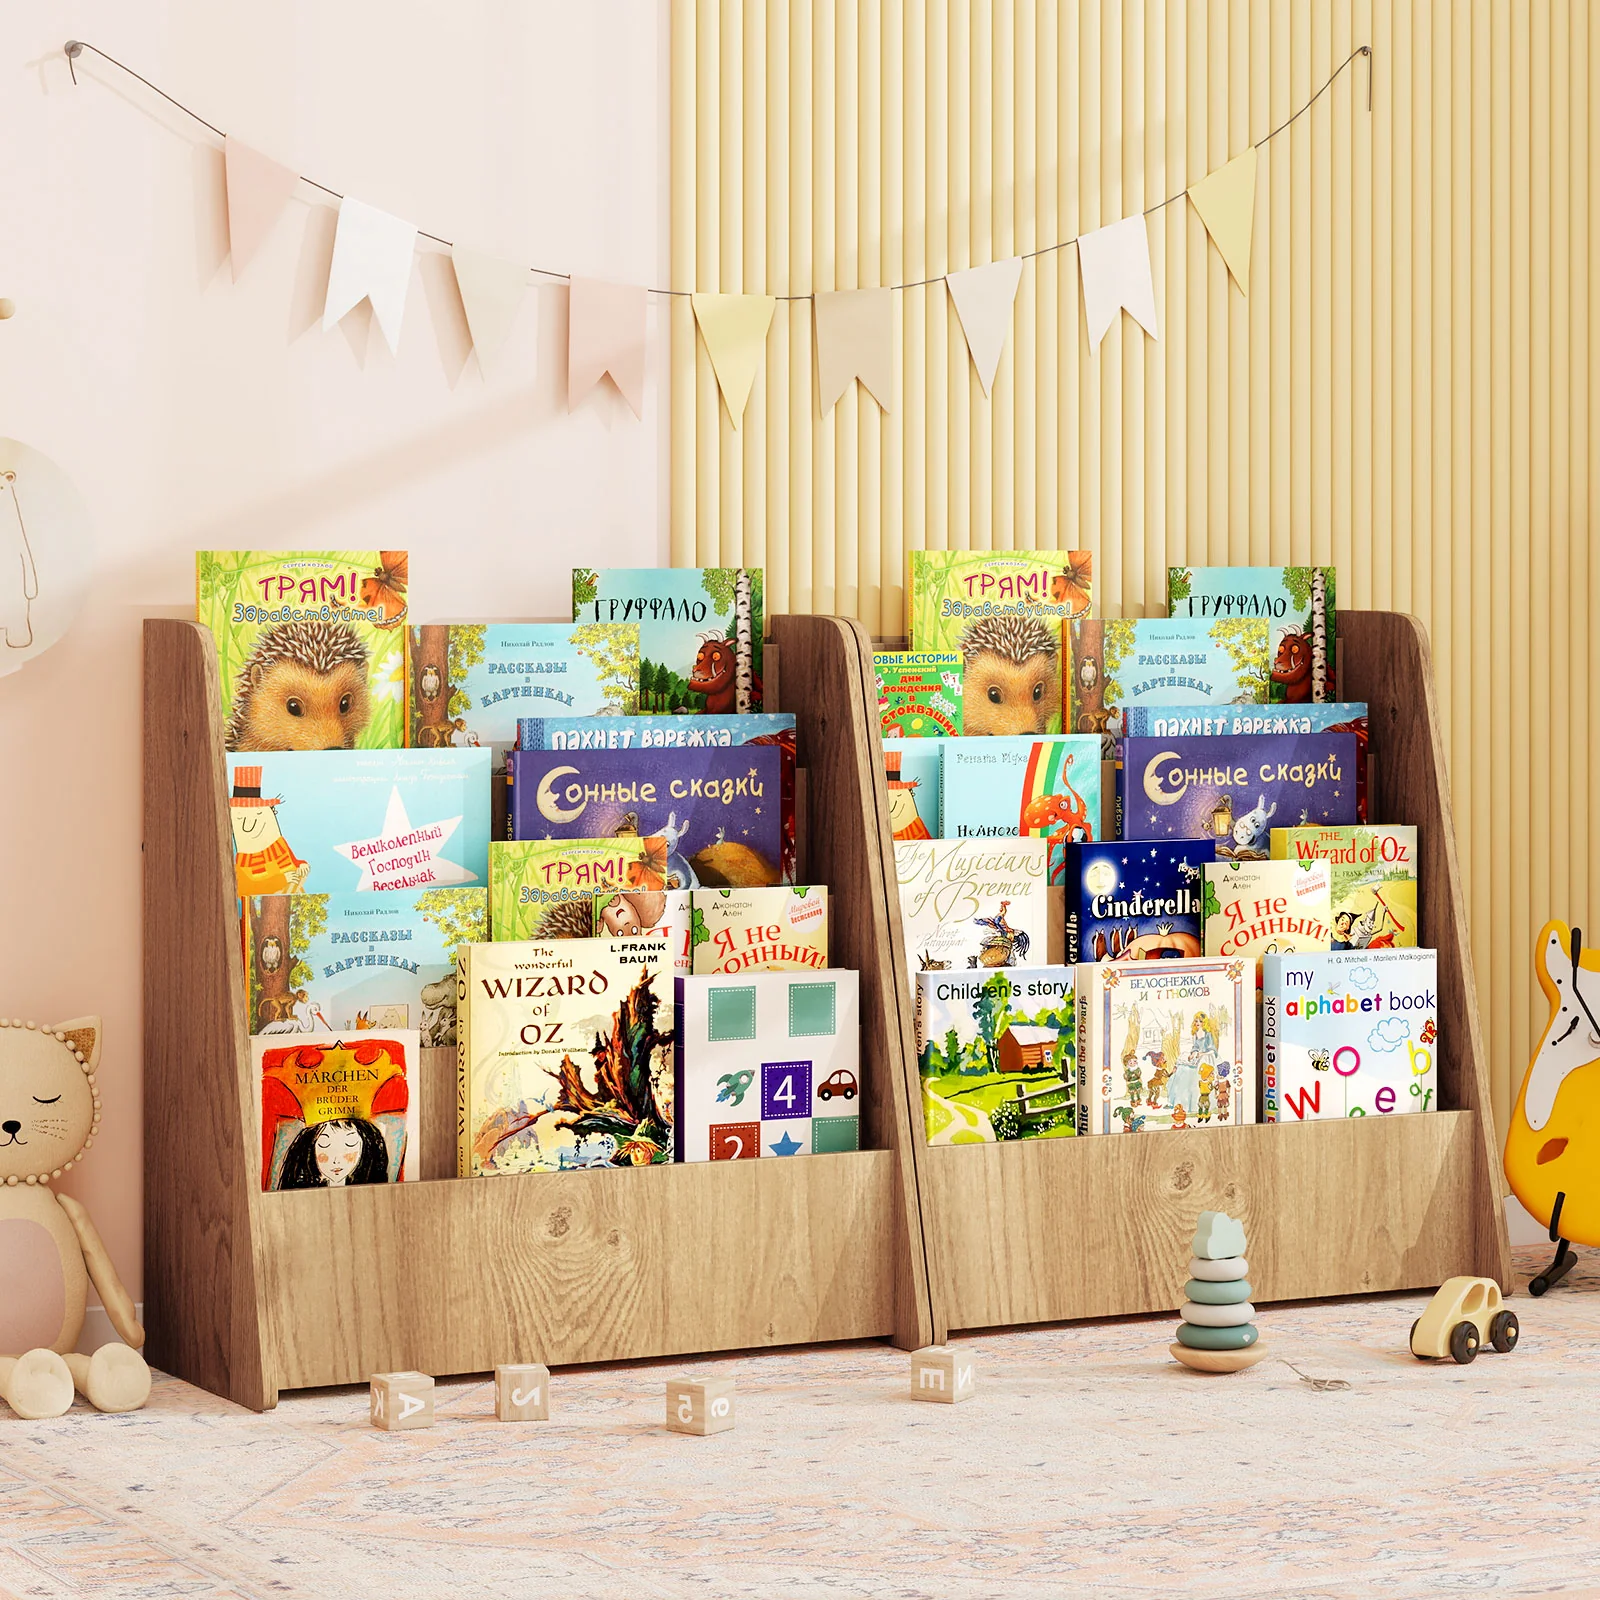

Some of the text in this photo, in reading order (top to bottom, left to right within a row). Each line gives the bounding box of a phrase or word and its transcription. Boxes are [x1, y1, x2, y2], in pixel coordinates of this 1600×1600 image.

[257, 572, 357, 603] ТРЯМ!
[963, 570, 1049, 599] ТРЯМ!
[233, 603, 383, 624] Здравствуйте!
[593, 597, 707, 623] ГРУФФАЛО
[941, 599, 1071, 618] Здравствуйте!
[1187, 594, 1287, 618] ГРУФФАЛО
[500, 640, 555, 648] Николай Радлов
[1149, 633, 1175, 641] Николай
[487, 661, 568, 675] РАССКАЗЫ
[873, 653, 958, 665] ОВЫЕ ИСТОРИИ
[1138, 654, 1208, 666] РАССКАЗЫ
[480, 685, 576, 708] КАРТИНКАХ
[1131, 676, 1215, 697] КАРТИНКАХ
[1259, 761, 1342, 788] сказки
[669, 775, 764, 805] сказки
[1295, 836, 1410, 864] Wizard of Oz
[368, 850, 432, 876] Господин
[541, 857, 623, 885] ТРЯМ!
[896, 840, 1045, 884] Musicians
[1232, 882, 1252, 890] Ален
[343, 907, 400, 916] Николай Радлов
[712, 901, 753, 910] Джонатан
[722, 909, 743, 917] Ален
[1091, 889, 1201, 919] Cinderella
[1224, 897, 1288, 931] Я не
[331, 929, 413, 944] РАССКАЗЫ
[713, 924, 781, 959] Я не
[1066, 911, 1078, 963] erella
[1219, 916, 1330, 957] сонный!
[532, 948, 554, 957] The
[619, 955, 659, 964] BAUM
[1344, 955, 1368, 964] Mitchell
[322, 954, 421, 978] КАРТИНКАХ
[514, 959, 573, 970] wonderful
[480, 969, 609, 999] WIZARD
[1130, 975, 1206, 990] БЕЛОСНЕЖКА
[1286, 970, 1314, 990] my
[916, 984, 924, 1016] story
[936, 981, 1069, 1001] Children's story
[1139, 987, 1211, 1001] И 7 ГНОМОВ
[532, 1003, 550, 1017] of
[1286, 989, 1436, 1020] alphabet book
[1265, 997, 1276, 1038] book
[519, 1022, 564, 1045] OZ
[1079, 1046, 1087, 1063] the
[295, 1069, 379, 1085] MÄRCHEN
[1079, 1067, 1087, 1086] and
[327, 1085, 348, 1093] DER
[773, 1074, 797, 1109] 4
[316, 1095, 359, 1105] BRÜDER
[318, 1106, 355, 1115] GRIMM
[1375, 1087, 1396, 1113] e
[724, 1135, 744, 1160] 2
[399, 1392, 425, 1420] A
